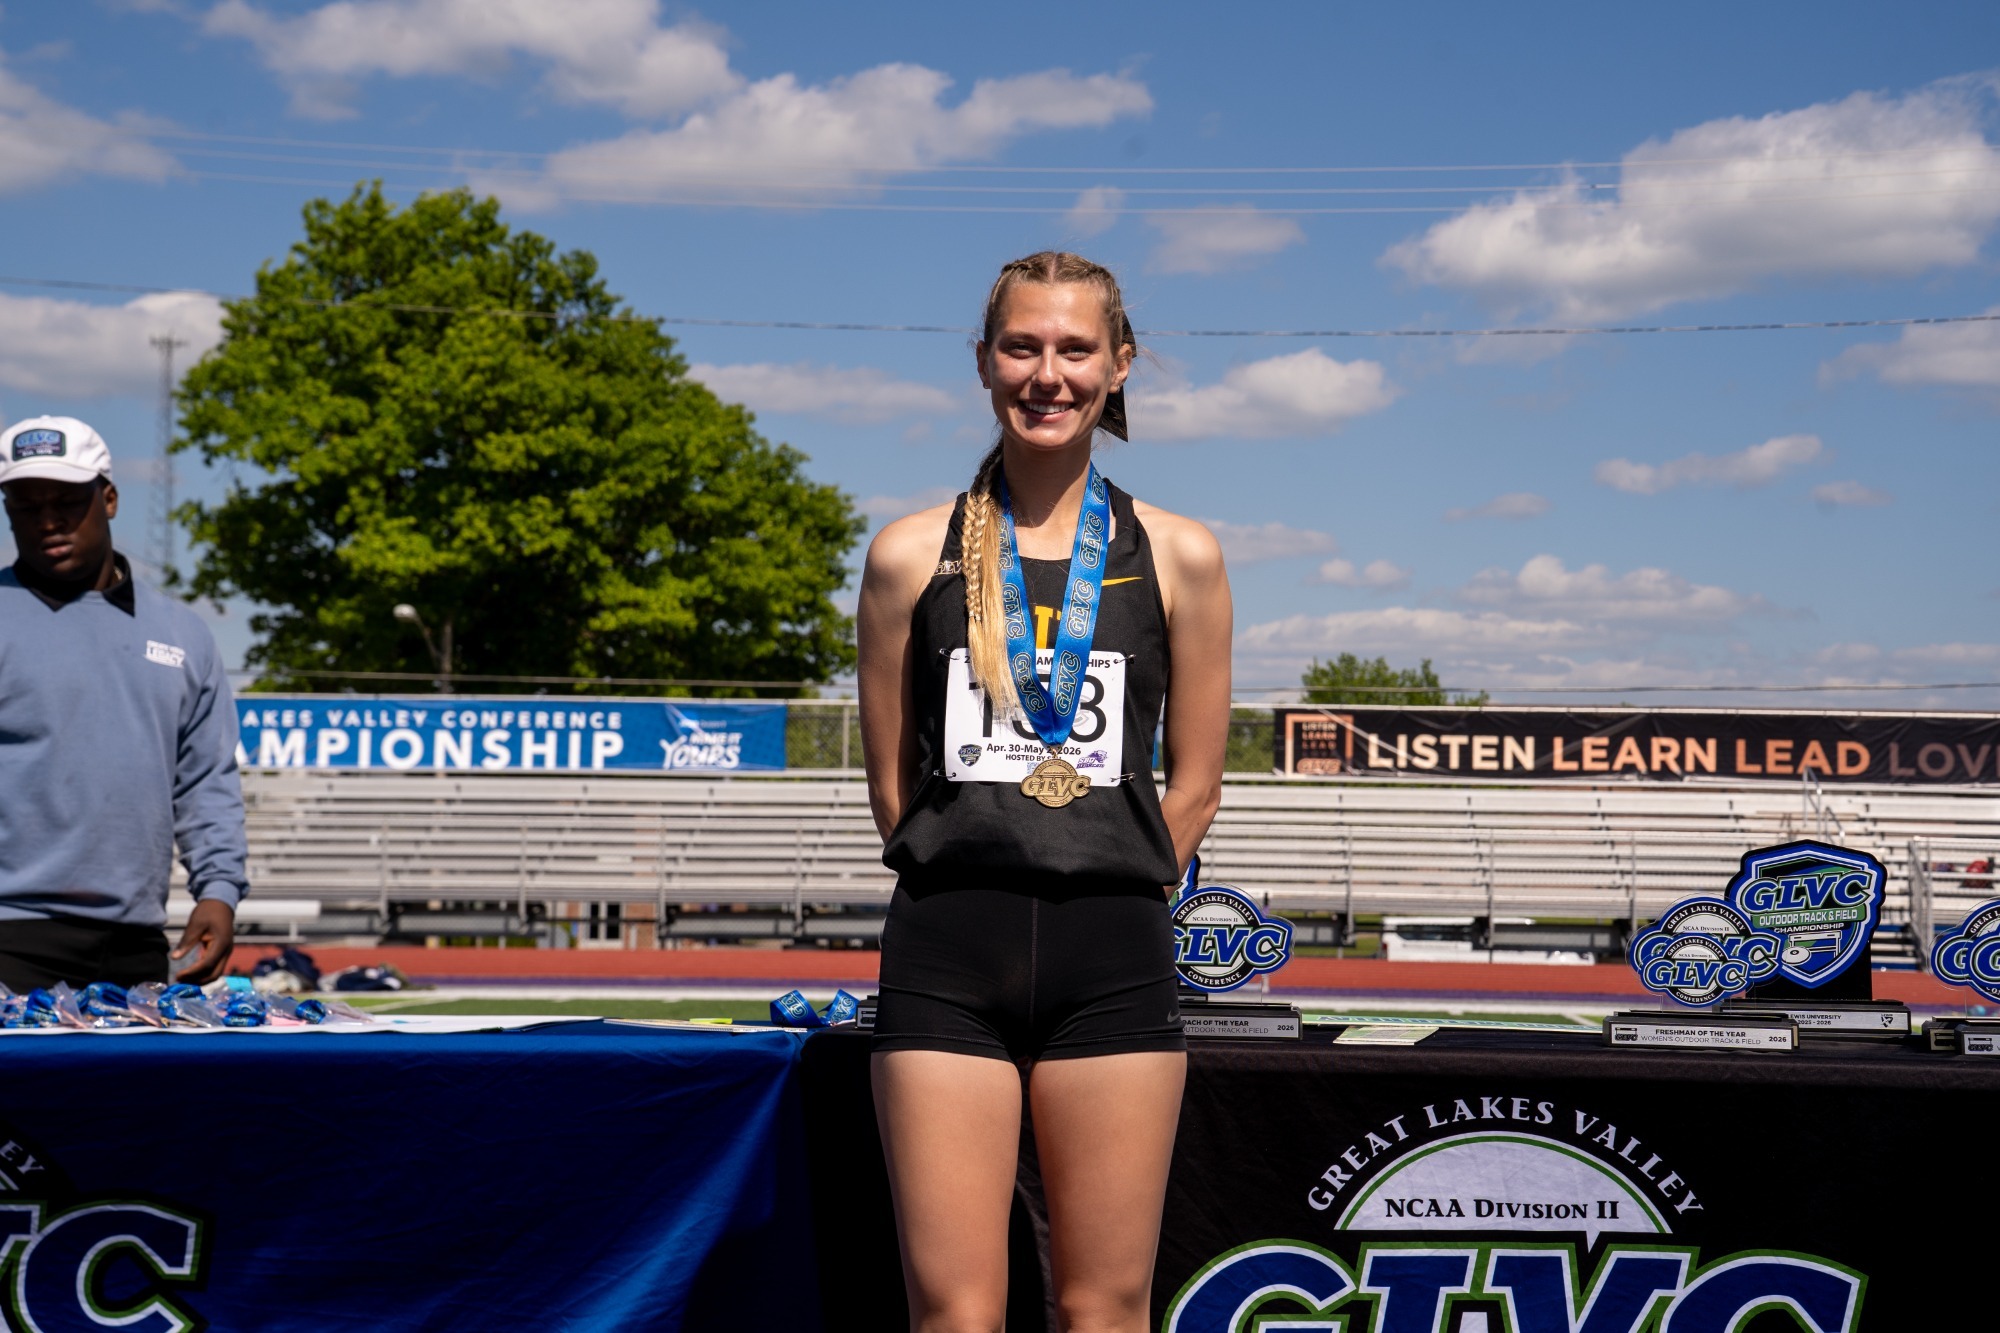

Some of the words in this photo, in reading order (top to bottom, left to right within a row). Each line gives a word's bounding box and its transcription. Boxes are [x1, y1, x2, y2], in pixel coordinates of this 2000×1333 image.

[1079, 510, 1104, 569] GLVC
[1001, 583, 1026, 639] GLVC
[1066, 578, 1094, 639] GLVC
[1013, 652, 1047, 713] GLVC
[1054, 650, 1081, 717] GLVC
[242, 709, 314, 728] AKES
[326, 709, 428, 728] VALLEY
[441, 710, 622, 729] CONFERENCE
[234, 729, 625, 770] MPIONSHIP
[659, 735, 741, 769] YOURS
[987, 743, 1006, 753] Apr.
[1008, 744, 1044, 755] 30-May
[1057, 746, 1081, 755] 2026
[1368, 733, 1535, 771] LISTEN
[1553, 736, 1717, 773] LEARN
[1736, 738, 1871, 775] LEAD
[1889, 741, 2000, 778] LOV
[1020, 775, 1091, 797] GLVC
[1741, 871, 1872, 914] GLVC
[1177, 900, 1198, 919] GREAT
[1229, 899, 1254, 921] VALLEY
[1667, 911, 1689, 930] GREAT
[1691, 905, 1717, 913] LAKES
[1720, 908, 1745, 931] VALLEY
[1759, 915, 1799, 926] OUTDOOR
[1799, 911, 1828, 922] TRACK
[1828, 911, 1835, 920] &
[1835, 909, 1858, 919] FIELD
[1970, 912, 1992, 934] GREAT
[1774, 923, 1845, 934] CHAMPIONSHIP
[1188, 971, 1241, 985] CONFERENCE
[1643, 957, 1749, 991] GLVC
[1676, 992, 1716, 1003] CONFERENCE
[1307, 1115, 1410, 1211] GREAT
[1423, 1096, 1555, 1129] LAKES
[1574, 1109, 1704, 1215] VALLEY
[1384, 1198, 1466, 1218] NCAA
[1596, 1200, 1619, 1219] II
